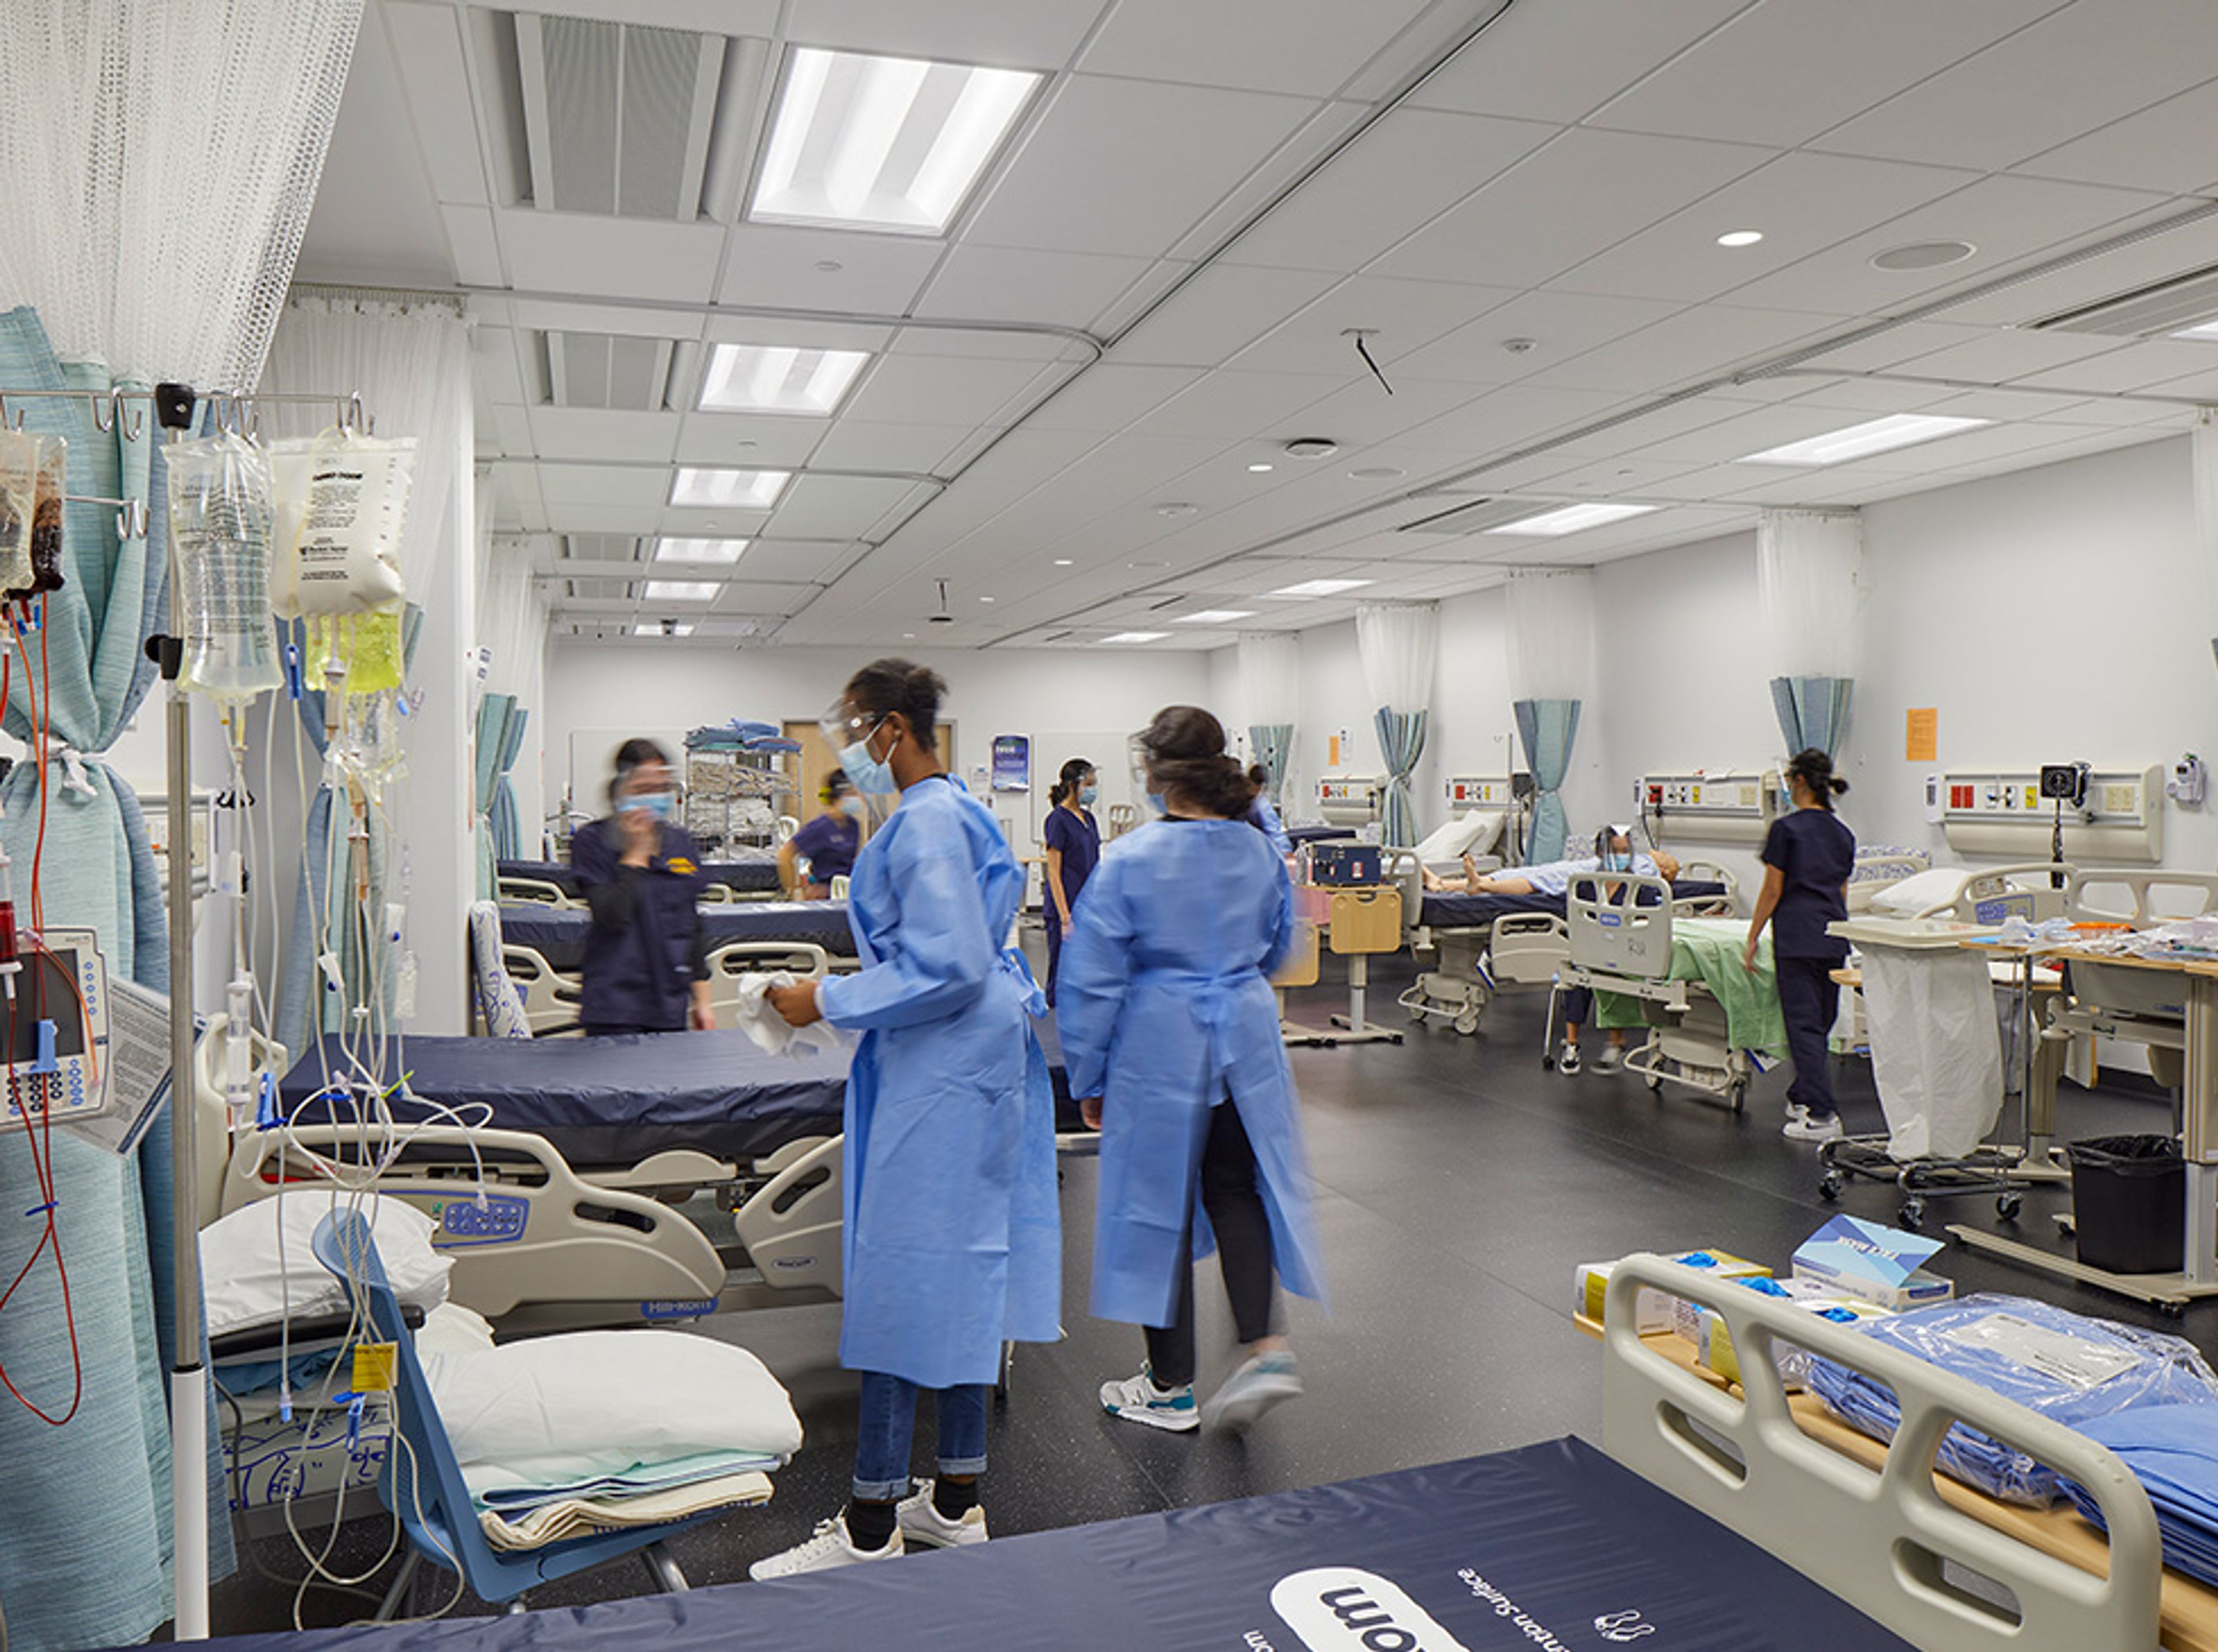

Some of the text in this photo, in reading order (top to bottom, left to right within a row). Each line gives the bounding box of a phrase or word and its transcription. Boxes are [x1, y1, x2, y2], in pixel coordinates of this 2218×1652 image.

[1319, 1586, 1424, 1652] om
[1457, 1568, 1572, 1652] ntion Surface
